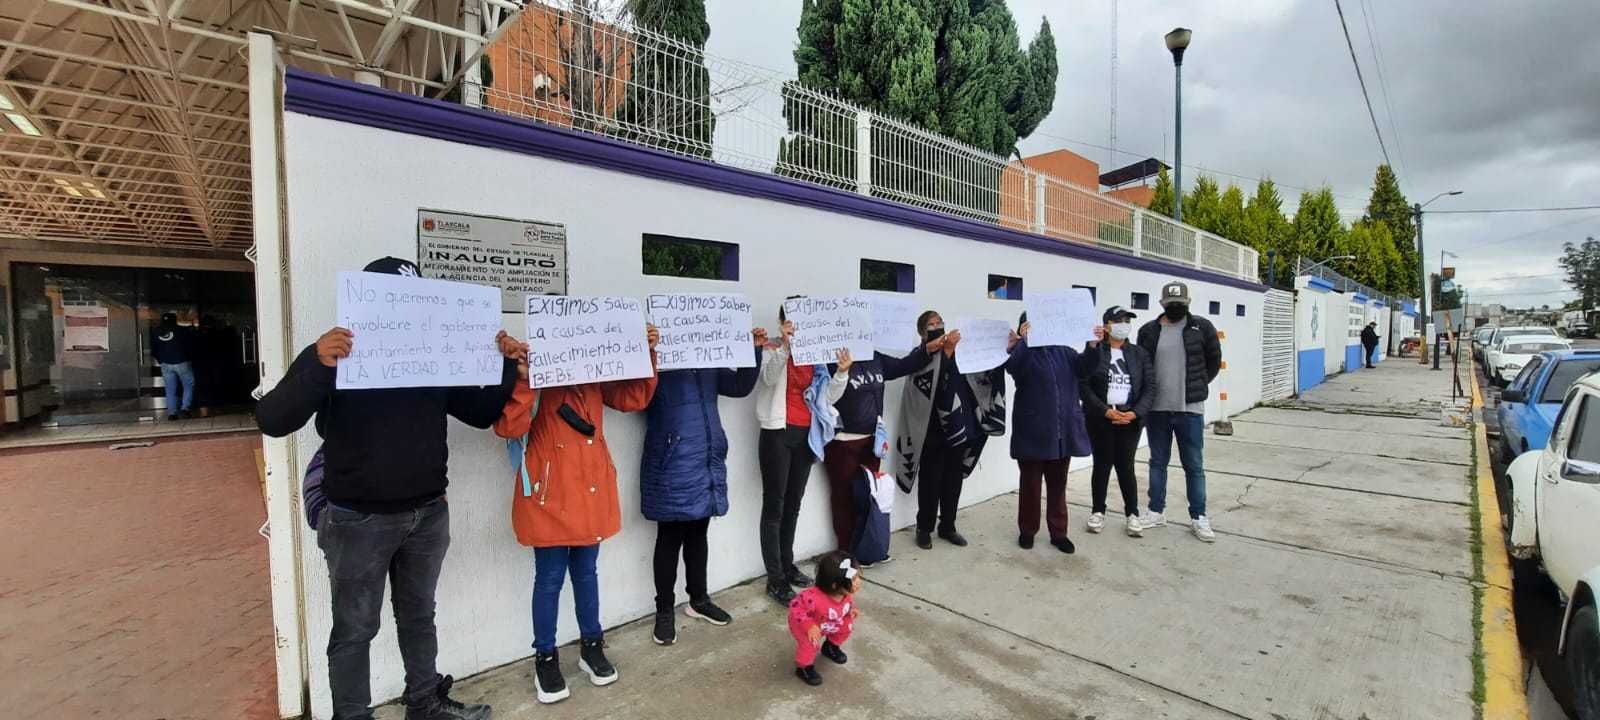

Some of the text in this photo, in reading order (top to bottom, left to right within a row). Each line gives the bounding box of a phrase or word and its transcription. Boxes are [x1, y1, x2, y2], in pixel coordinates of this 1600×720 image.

[437, 243, 470, 251] GOBIERNO
[523, 250, 555, 258] TLAXCALA
[424, 263, 488, 273] MEJORAMIENTO
[491, 267, 505, 275] Y/O
[435, 272, 551, 285] LA AGENCIA DEL MINISTERIO
[346, 278, 376, 303] No
[385, 291, 447, 311] queremos
[505, 285, 544, 293] APIZACO
[345, 313, 412, 331] involucre
[420, 313, 432, 331] el
[440, 317, 487, 338] gobierno
[673, 314, 711, 327] causa
[715, 313, 732, 327] del
[801, 319, 831, 329] causa
[835, 317, 850, 328] del
[551, 324, 597, 339] causa
[604, 321, 623, 334] del
[857, 330, 873, 342] del
[656, 327, 750, 347] allecimiento del
[442, 341, 457, 353] de
[624, 340, 643, 353] del
[346, 364, 369, 384] LA
[382, 360, 439, 380] VERDAD
[448, 361, 466, 376] DE
[1107, 374, 1131, 385] dida
